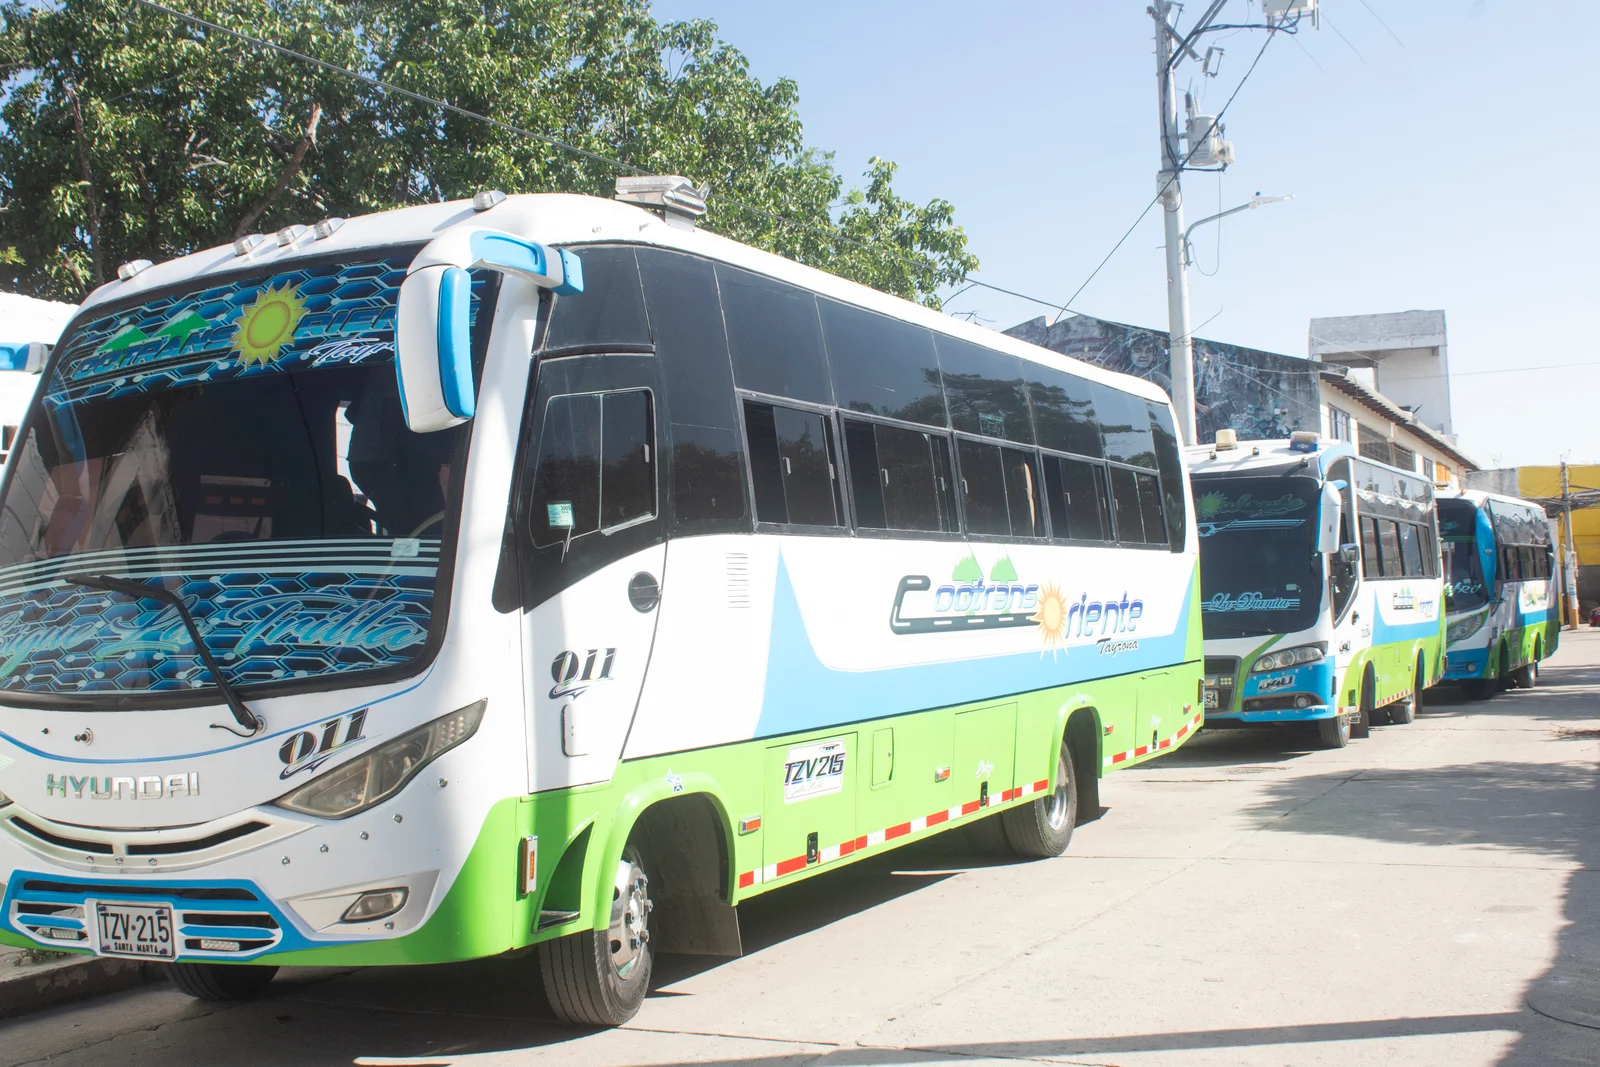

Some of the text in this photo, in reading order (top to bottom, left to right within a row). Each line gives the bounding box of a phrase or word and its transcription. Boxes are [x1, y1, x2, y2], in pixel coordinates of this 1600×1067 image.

[225, 592, 428, 653] Trilla
[1096, 637, 1138, 655] Tayrona
[46, 772, 199, 800] HYUNDAI
[114, 942, 159, 954] SANTA MARTA
